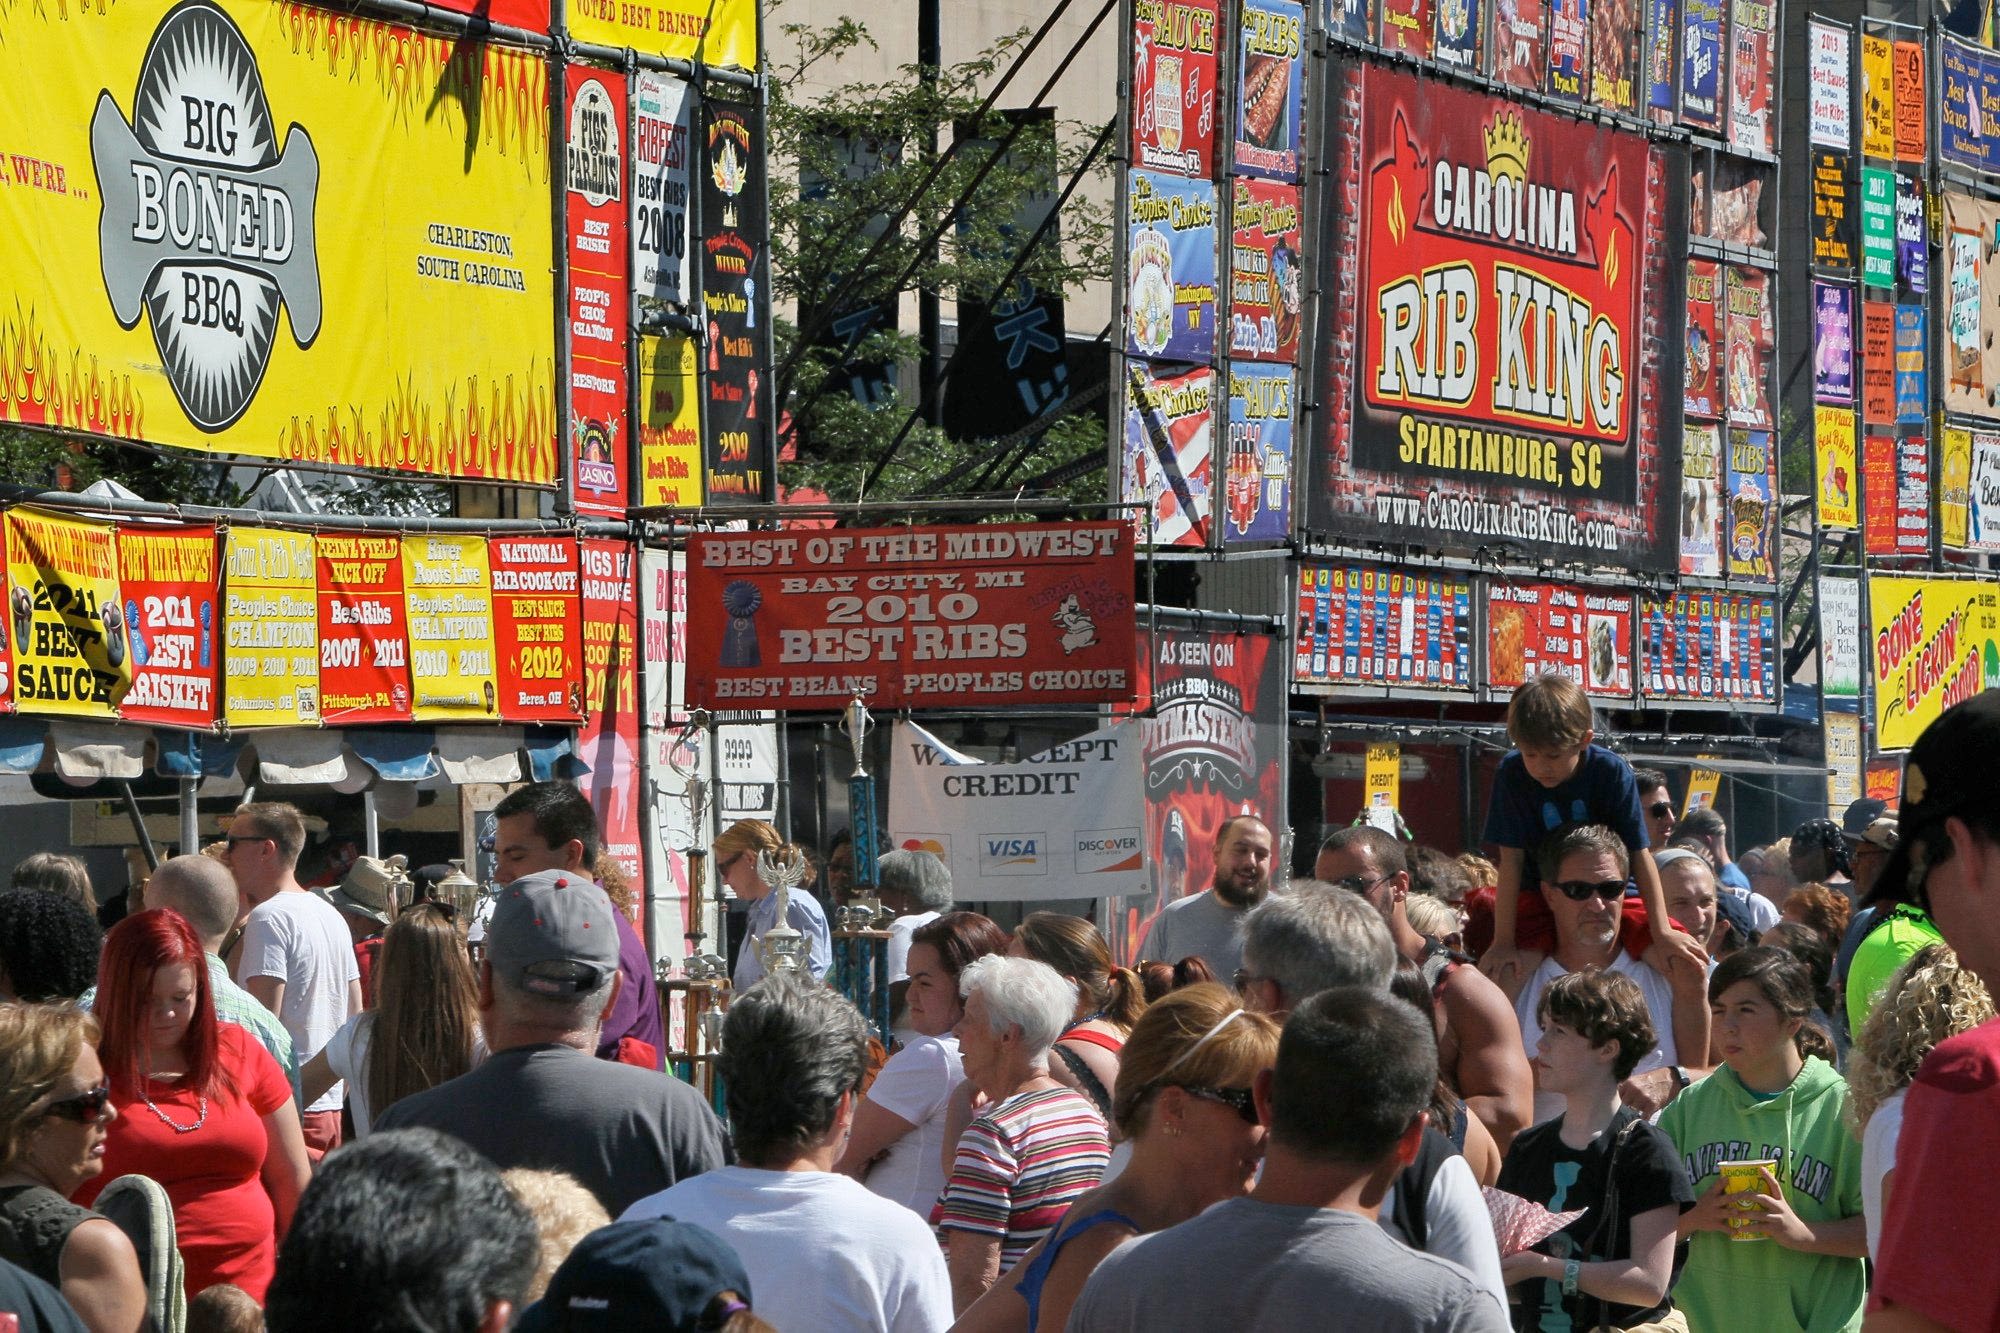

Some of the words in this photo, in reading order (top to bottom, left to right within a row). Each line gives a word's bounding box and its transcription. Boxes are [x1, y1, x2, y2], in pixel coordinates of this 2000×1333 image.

[621, 2, 650, 29] BEST
[1153, 5, 1215, 53] SAUCE
[1254, 12, 1299, 60] RIBS
[1946, 76, 1965, 103] Best
[181, 95, 238, 156] BIG
[581, 107, 608, 153] PIGS
[1944, 101, 1967, 130] Sauce
[638, 115, 687, 171] RIBFEST
[10, 155, 66, 194] WERE
[638, 174, 663, 204] BEST
[663, 180, 686, 209] RIBS
[131, 160, 294, 264] BONED
[1169, 194, 1213, 231] Choice
[1433, 160, 1577, 255] CAROLINA
[428, 223, 514, 260] CHARLESTON,
[638, 204, 685, 260] 2008
[417, 255, 460, 282] SOUTH
[464, 262, 526, 292] CAROLINA
[181, 271, 244, 338] BBQ
[1233, 315, 1260, 355] Erie,
[1260, 316, 1278, 352] PA
[1377, 259, 1480, 409] RIB
[1492, 260, 1624, 435] KING
[1160, 380, 1209, 419] Choice
[1244, 375, 1290, 421] SAUCE
[1571, 440, 1602, 490] SC
[1732, 444, 1766, 475] RIBS
[580, 467, 614, 485] CASINO
[360, 539, 398, 560] FIELD
[426, 539, 461, 561] River
[500, 543, 567, 563] NATIONAL
[702, 540, 798, 567] BEST
[804, 536, 854, 565] OF
[860, 532, 937, 562] THE
[944, 528, 1119, 560] MIDWEST
[362, 563, 387, 584] OFF
[413, 563, 452, 583] Roots
[452, 564, 480, 584] Live
[493, 571, 519, 590] RIB
[780, 577, 859, 594] BAY
[866, 573, 963, 593] CITY,
[975, 571, 1025, 588] MI
[33, 579, 100, 621] 2011
[228, 595, 278, 621] Peoples
[280, 595, 315, 617] Choice
[361, 602, 392, 625] Ribs
[409, 594, 452, 618] Peoples
[453, 595, 487, 613] Choice
[512, 599, 537, 618] BEST
[538, 600, 565, 618] SAUCE
[826, 593, 979, 623] 2010
[35, 622, 102, 660] BEST
[228, 621, 316, 648] CHAMPION
[411, 617, 488, 641] CHAMPION
[517, 624, 541, 641] BEST
[542, 624, 564, 641] RIBS
[1836, 620, 1855, 636] Best
[1877, 589, 1923, 681] BONE
[321, 638, 361, 668] 2007
[373, 638, 405, 667] 2011
[779, 627, 904, 664] BEST
[912, 623, 1027, 660] RIBS
[1160, 640, 1176, 665] AS
[1179, 641, 1210, 666] SEEN
[1214, 643, 1234, 667] ON
[1837, 638, 1856, 655] Ribs
[227, 657, 258, 677] 2009
[263, 658, 287, 677] 2010
[292, 658, 317, 677] 2011
[415, 650, 448, 677] 2010
[459, 650, 491, 676] 2011
[520, 646, 563, 679] 2012
[18, 664, 121, 703] SAUCE
[715, 677, 785, 698] BEST
[789, 676, 878, 696] BEANS
[903, 671, 1023, 694] PEOPLES
[1028, 669, 1126, 690] CHOICE
[1185, 677, 1209, 697] BBQ
[229, 697, 277, 712] Columbus,
[279, 697, 293, 710] OH
[322, 693, 374, 711] Pittsburgh,
[375, 692, 391, 707] PA
[518, 692, 547, 707] Berea,
[547, 692, 562, 705] OH
[943, 772, 1080, 798] CREDIT
[987, 839, 1038, 857] VISA
[1078, 837, 1137, 853] DISCOVER
